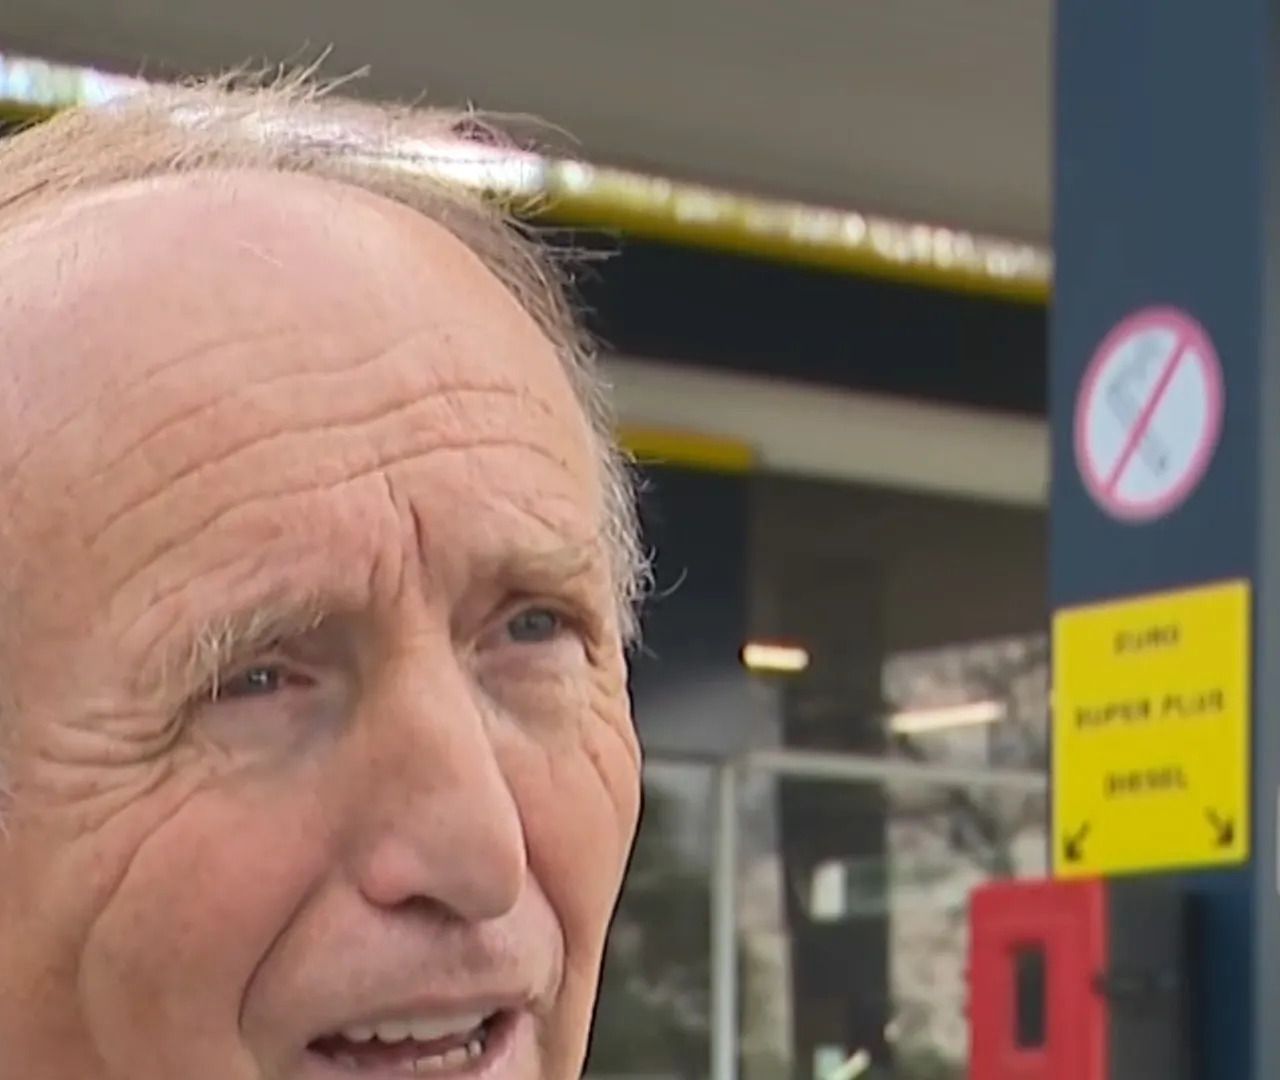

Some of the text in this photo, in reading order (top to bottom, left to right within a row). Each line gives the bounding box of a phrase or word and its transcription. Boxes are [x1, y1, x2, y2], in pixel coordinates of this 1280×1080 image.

[1114, 624, 1180, 654] EURO
[1075, 688, 1224, 730] SUPER PLUS
[1104, 766, 1187, 797] DIESEL
